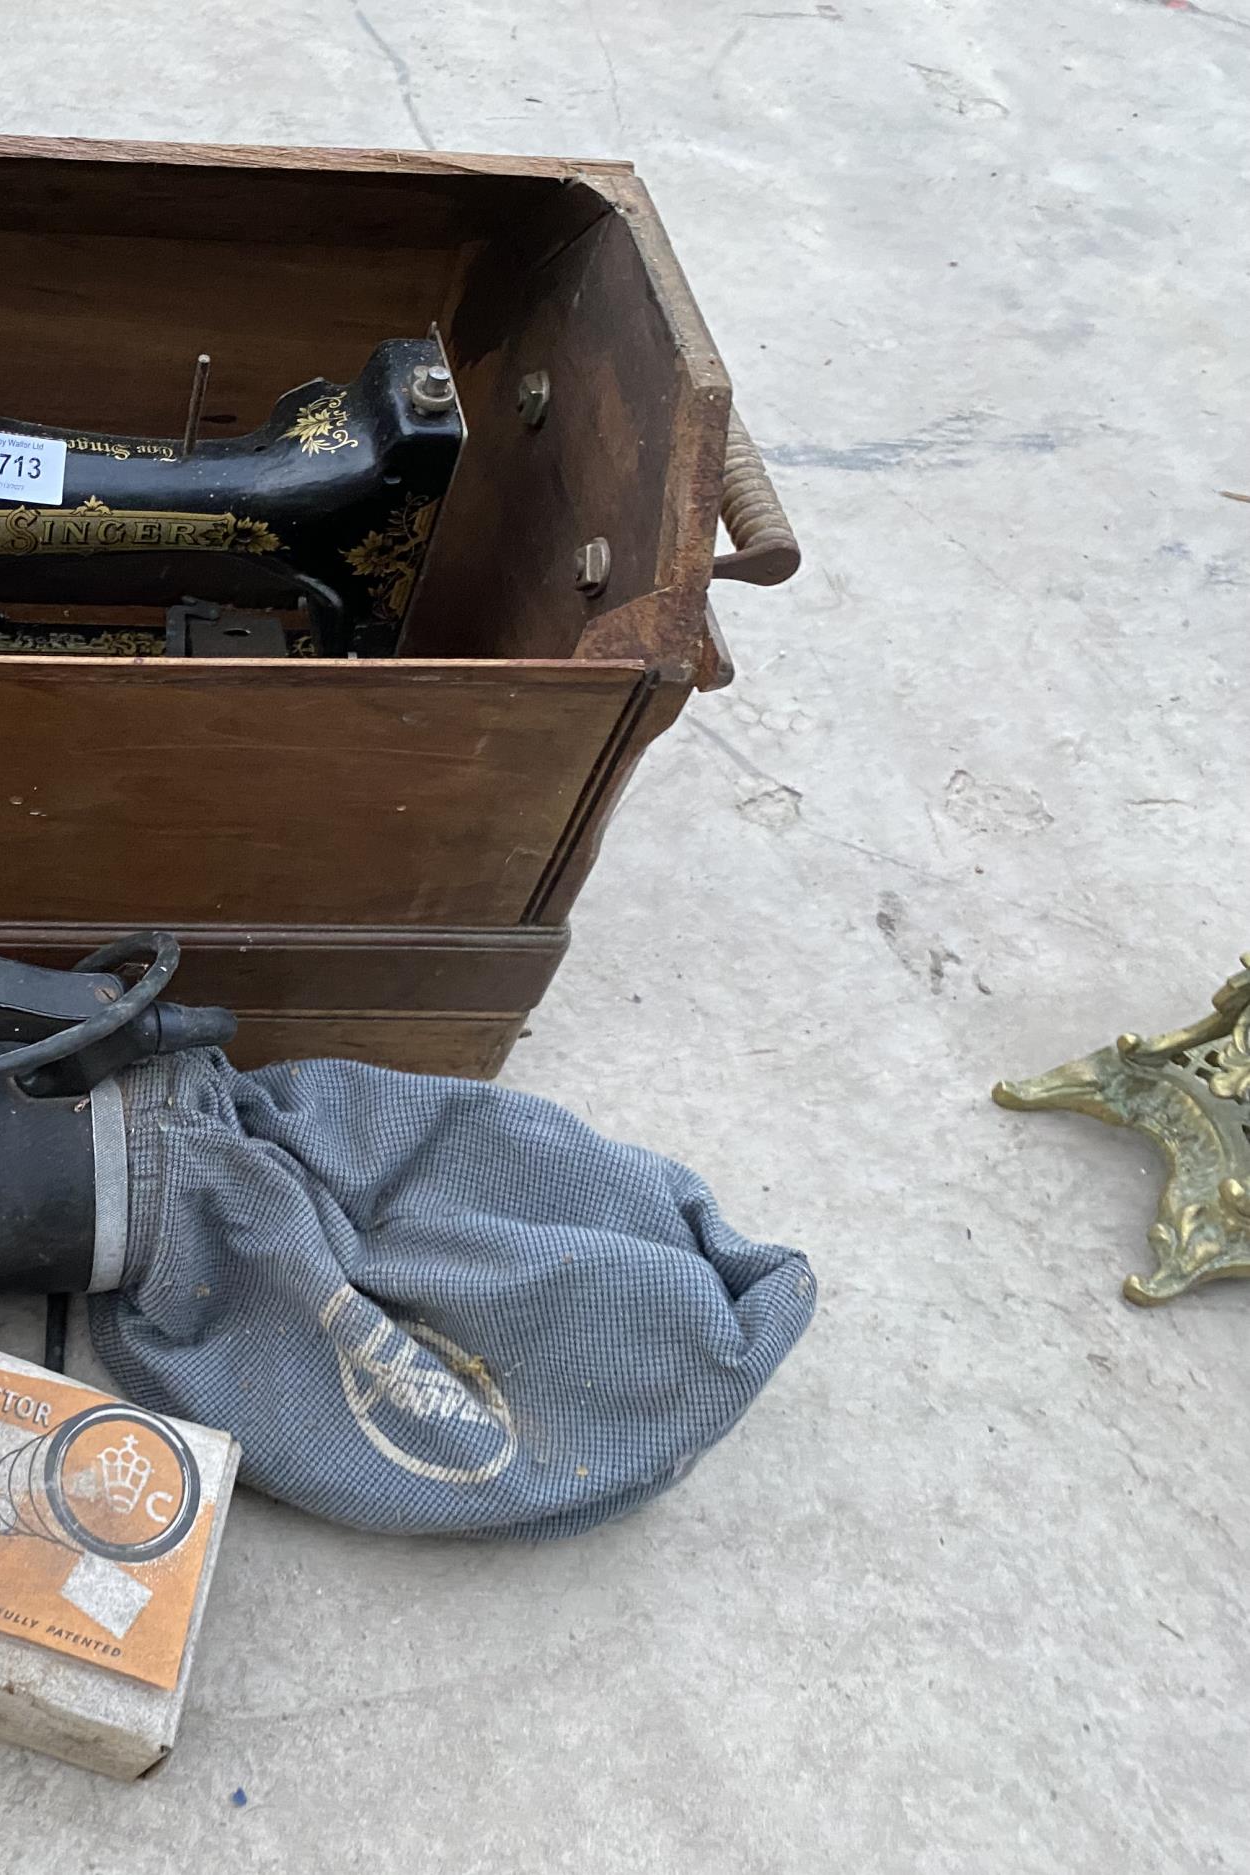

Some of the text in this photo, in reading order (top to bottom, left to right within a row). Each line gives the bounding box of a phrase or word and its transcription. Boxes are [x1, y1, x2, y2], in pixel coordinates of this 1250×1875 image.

[32, 442, 44, 451] Ltd
[66, 437, 131, 461] Singe
[46, 1624, 122, 1658] PATENTED
